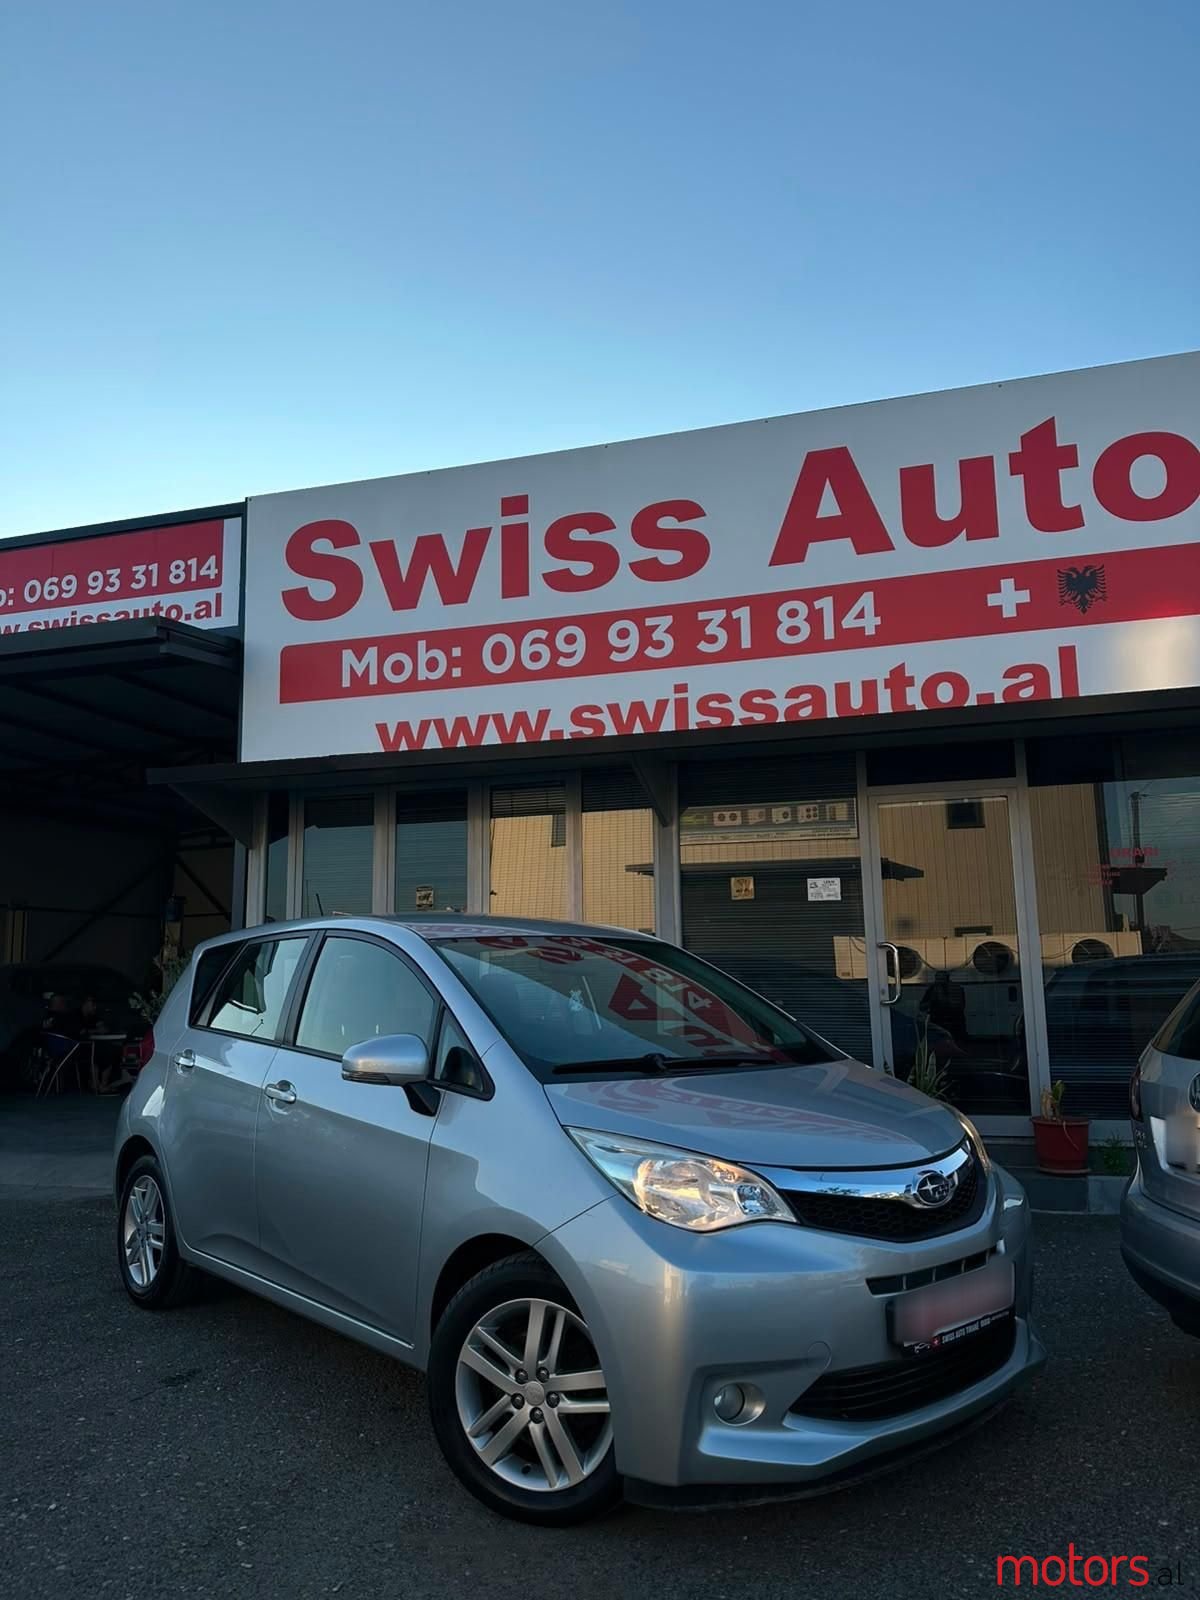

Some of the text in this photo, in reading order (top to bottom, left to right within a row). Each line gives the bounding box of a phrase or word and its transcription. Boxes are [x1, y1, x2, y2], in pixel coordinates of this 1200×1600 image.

[281, 416, 1200, 621] Swiss Auto
[24, 574, 78, 603] 069
[87, 568, 121, 596] 93
[130, 563, 158, 590] 31
[169, 555, 218, 585] 814
[342, 592, 881, 688] Mob: 069 93 31 814
[376, 645, 1080, 752] www.swissauto.al
